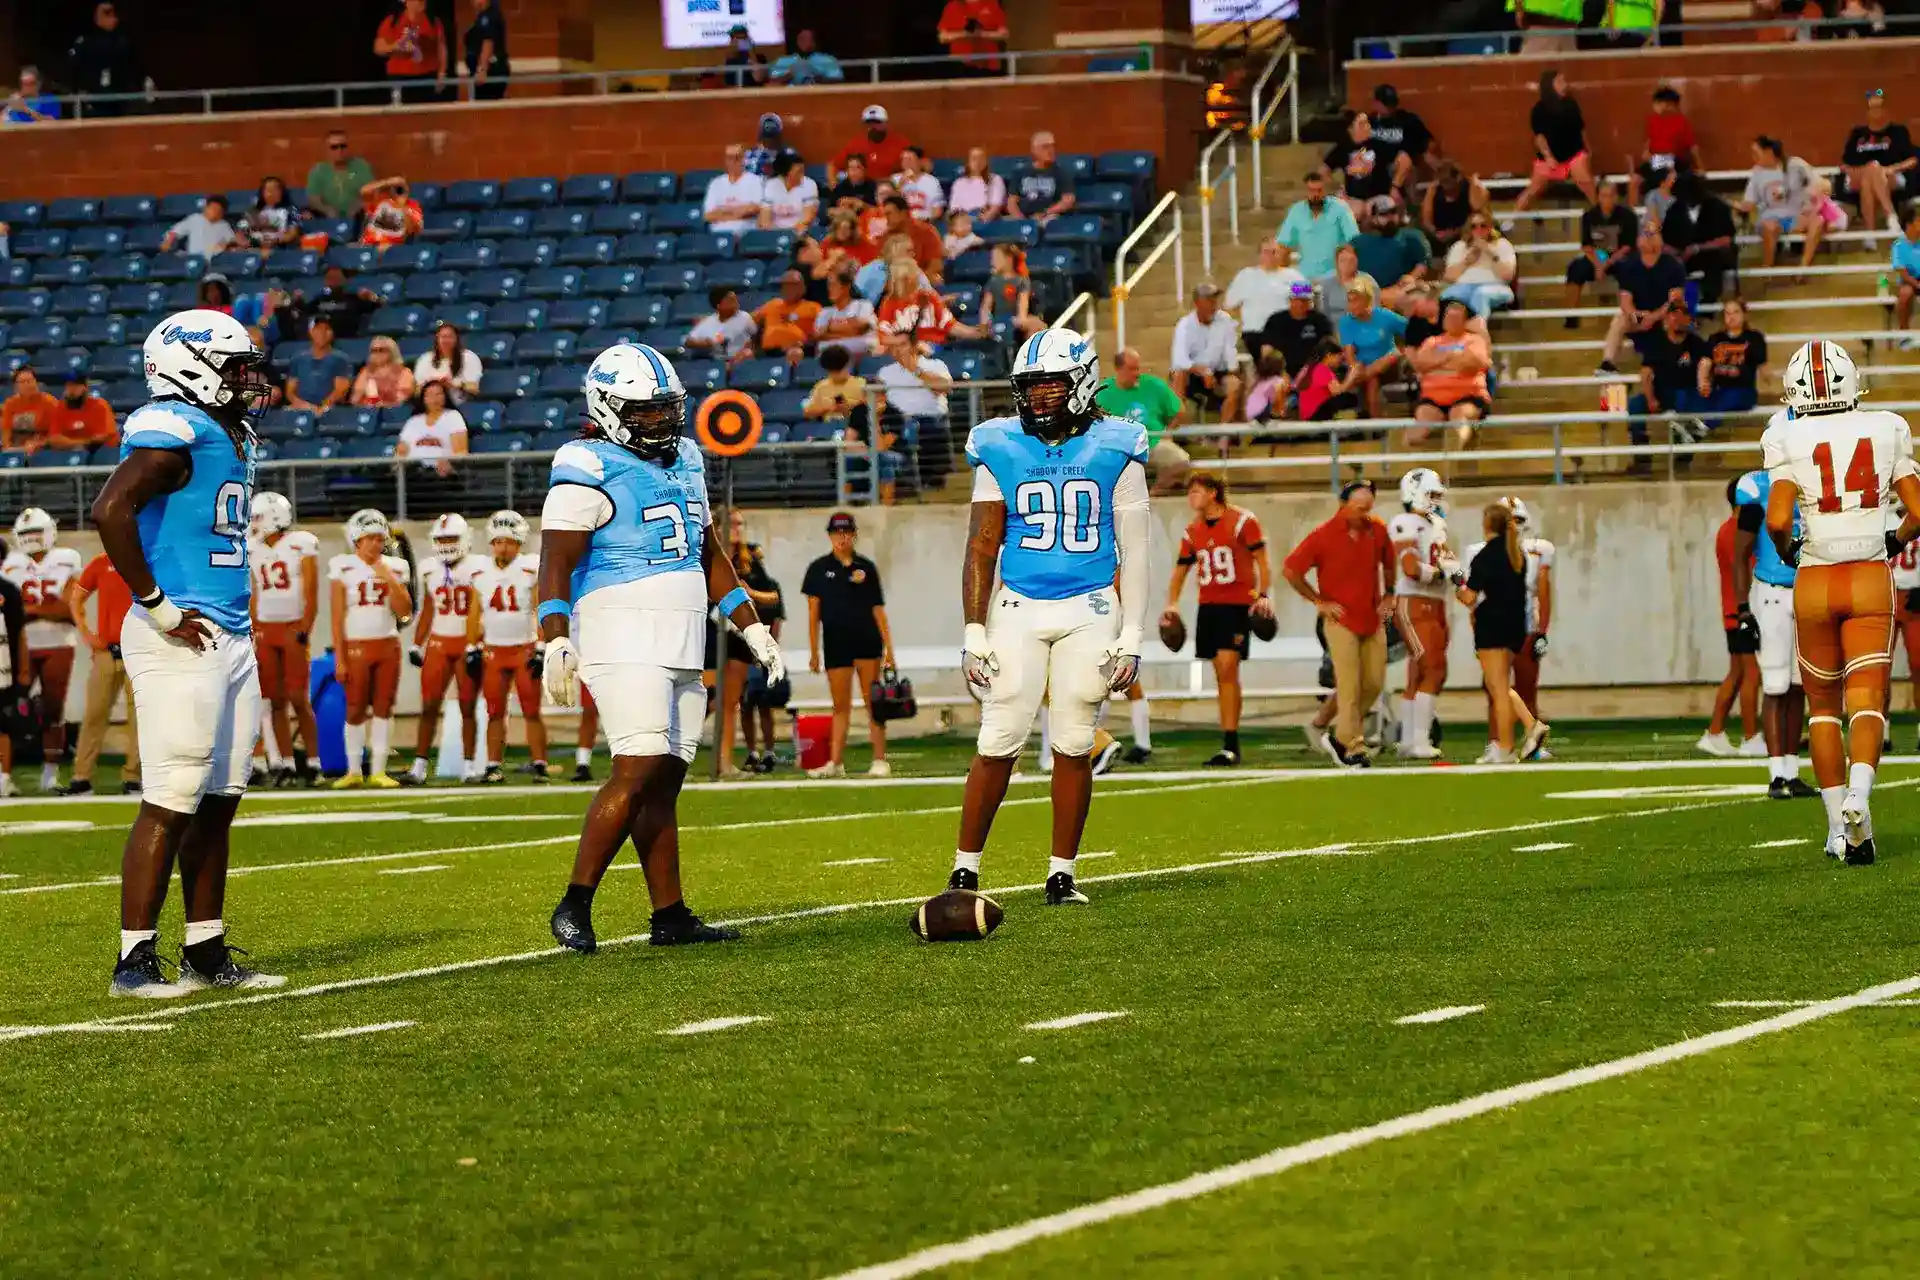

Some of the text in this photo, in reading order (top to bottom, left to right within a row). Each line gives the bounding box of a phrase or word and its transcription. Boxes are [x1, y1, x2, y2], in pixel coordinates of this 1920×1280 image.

[162, 325, 214, 345] Creek
[1025, 465, 1086, 477] SHADOW CREEK
[1811, 436, 1880, 513] 14
[1015, 478, 1102, 553] 90
[260, 560, 291, 592] 13
[21, 579, 58, 606] 65
[435, 585, 473, 617] 30
[489, 585, 520, 612] 41
